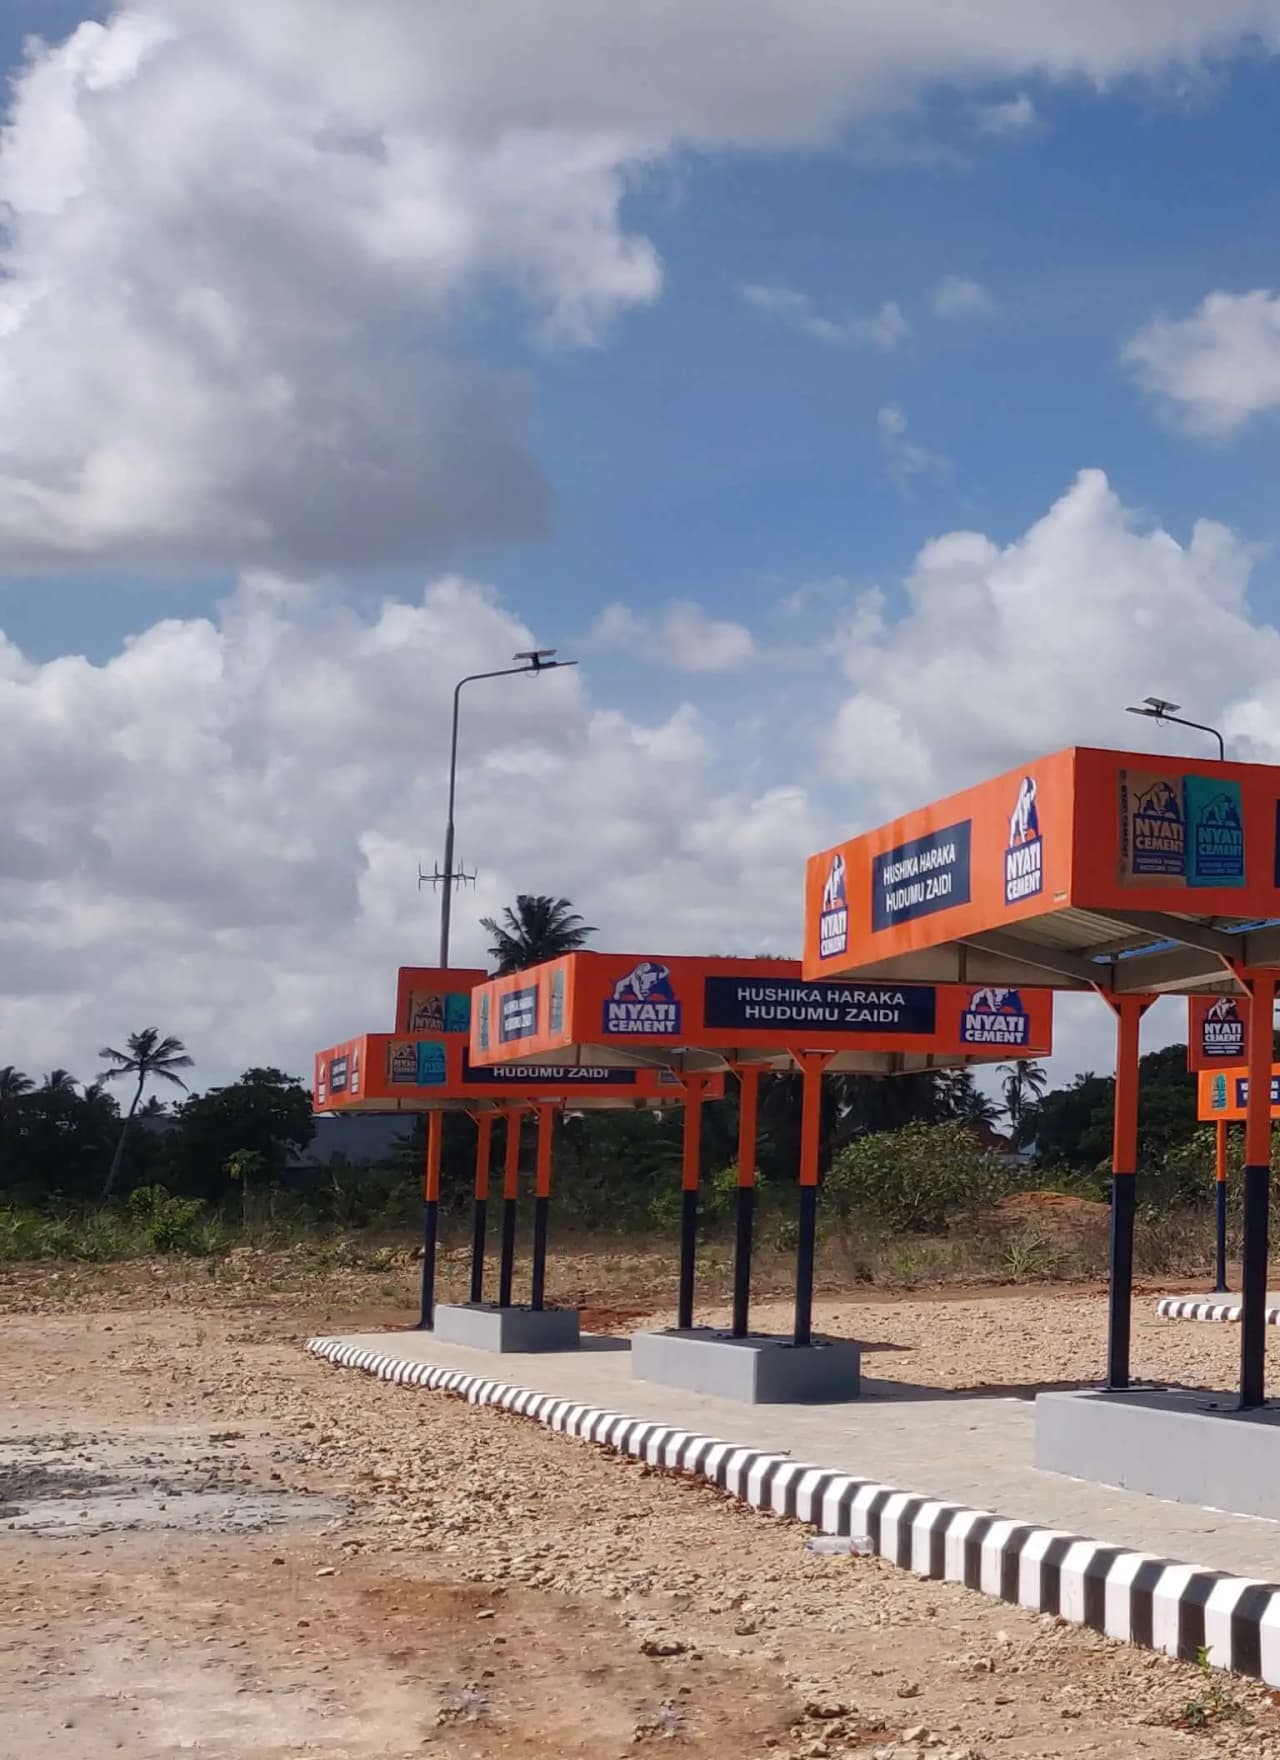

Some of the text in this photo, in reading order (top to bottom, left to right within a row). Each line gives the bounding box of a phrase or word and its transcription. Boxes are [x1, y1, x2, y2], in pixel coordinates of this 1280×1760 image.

[1136, 817, 1184, 840] NYATI
[1199, 827, 1242, 844] NYATI
[1136, 837, 1184, 854] CEMENT
[883, 843, 956, 886] HUSHIKA HARAKA
[1007, 842, 1040, 881] NYATI
[886, 873, 952, 913] HUDUMU ZAIDI
[1007, 869, 1040, 901] CEMENT
[821, 910, 847, 939] NYATI
[737, 987, 906, 1005] HUSHIKA HARAKA
[609, 1003, 676, 1020] NYATI
[745, 1005, 899, 1023] HUDUMU ZAIDI
[608, 1019, 675, 1033] CEMENT
[965, 1014, 1025, 1031] NYATI
[1204, 1023, 1241, 1034] NYATI
[965, 1029, 1025, 1043] CEMENT
[494, 1067, 609, 1079] HUDUMU ZAIDI
